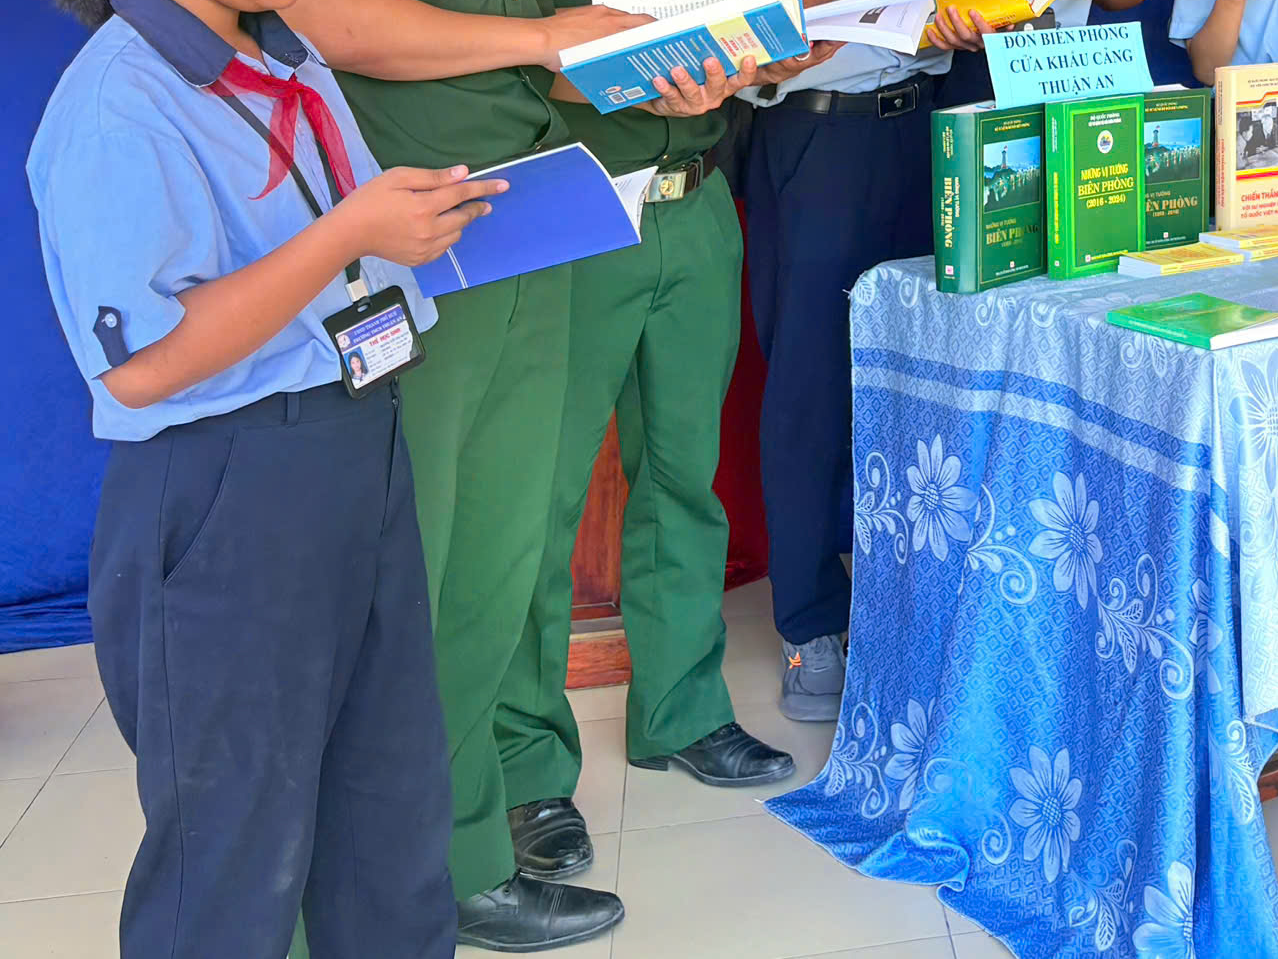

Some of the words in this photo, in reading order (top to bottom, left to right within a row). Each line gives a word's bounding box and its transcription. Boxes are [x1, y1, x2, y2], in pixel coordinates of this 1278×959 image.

[1079, 24, 1129, 43] PHÒNG
[1010, 54, 1043, 73] CỬA
[1093, 47, 1133, 66] CẢNG
[1039, 75, 1091, 95] THUẬN
[1095, 74, 1115, 89] AN
[1078, 180, 1100, 197] BIÊN
[1102, 176, 1134, 193] PHÒNG
[1241, 189, 1260, 202] CHIẾN
[1161, 194, 1198, 210] PHÒNG
